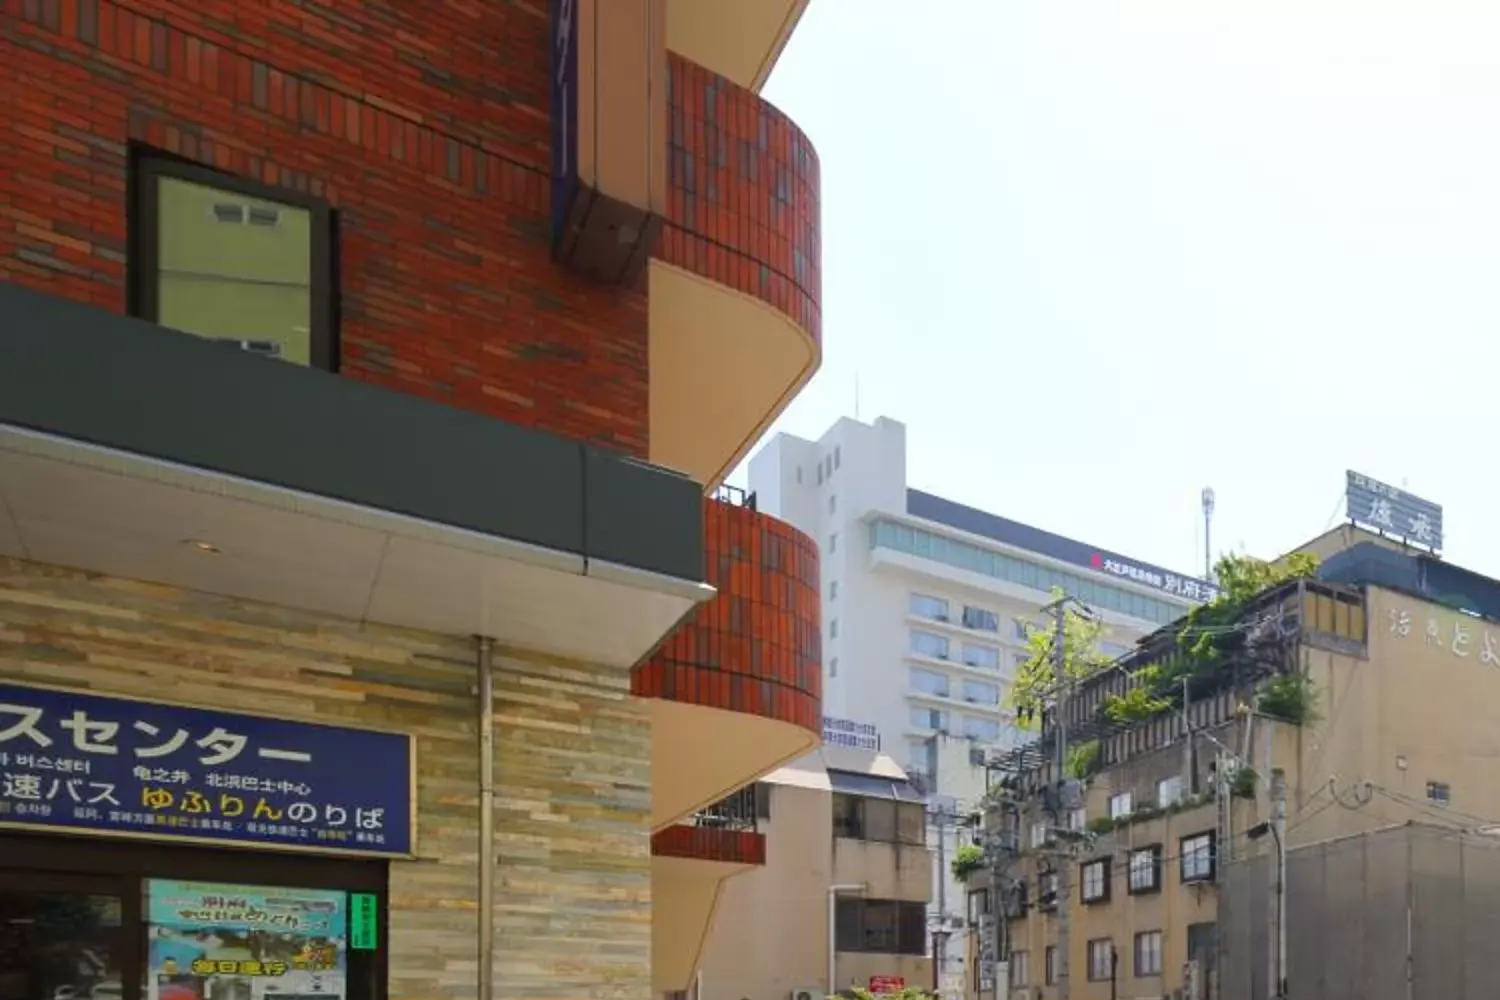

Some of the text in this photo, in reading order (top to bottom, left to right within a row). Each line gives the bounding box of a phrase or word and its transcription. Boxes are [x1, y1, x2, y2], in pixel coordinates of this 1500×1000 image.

[142, 786, 385, 830] ゆふりんのりば
